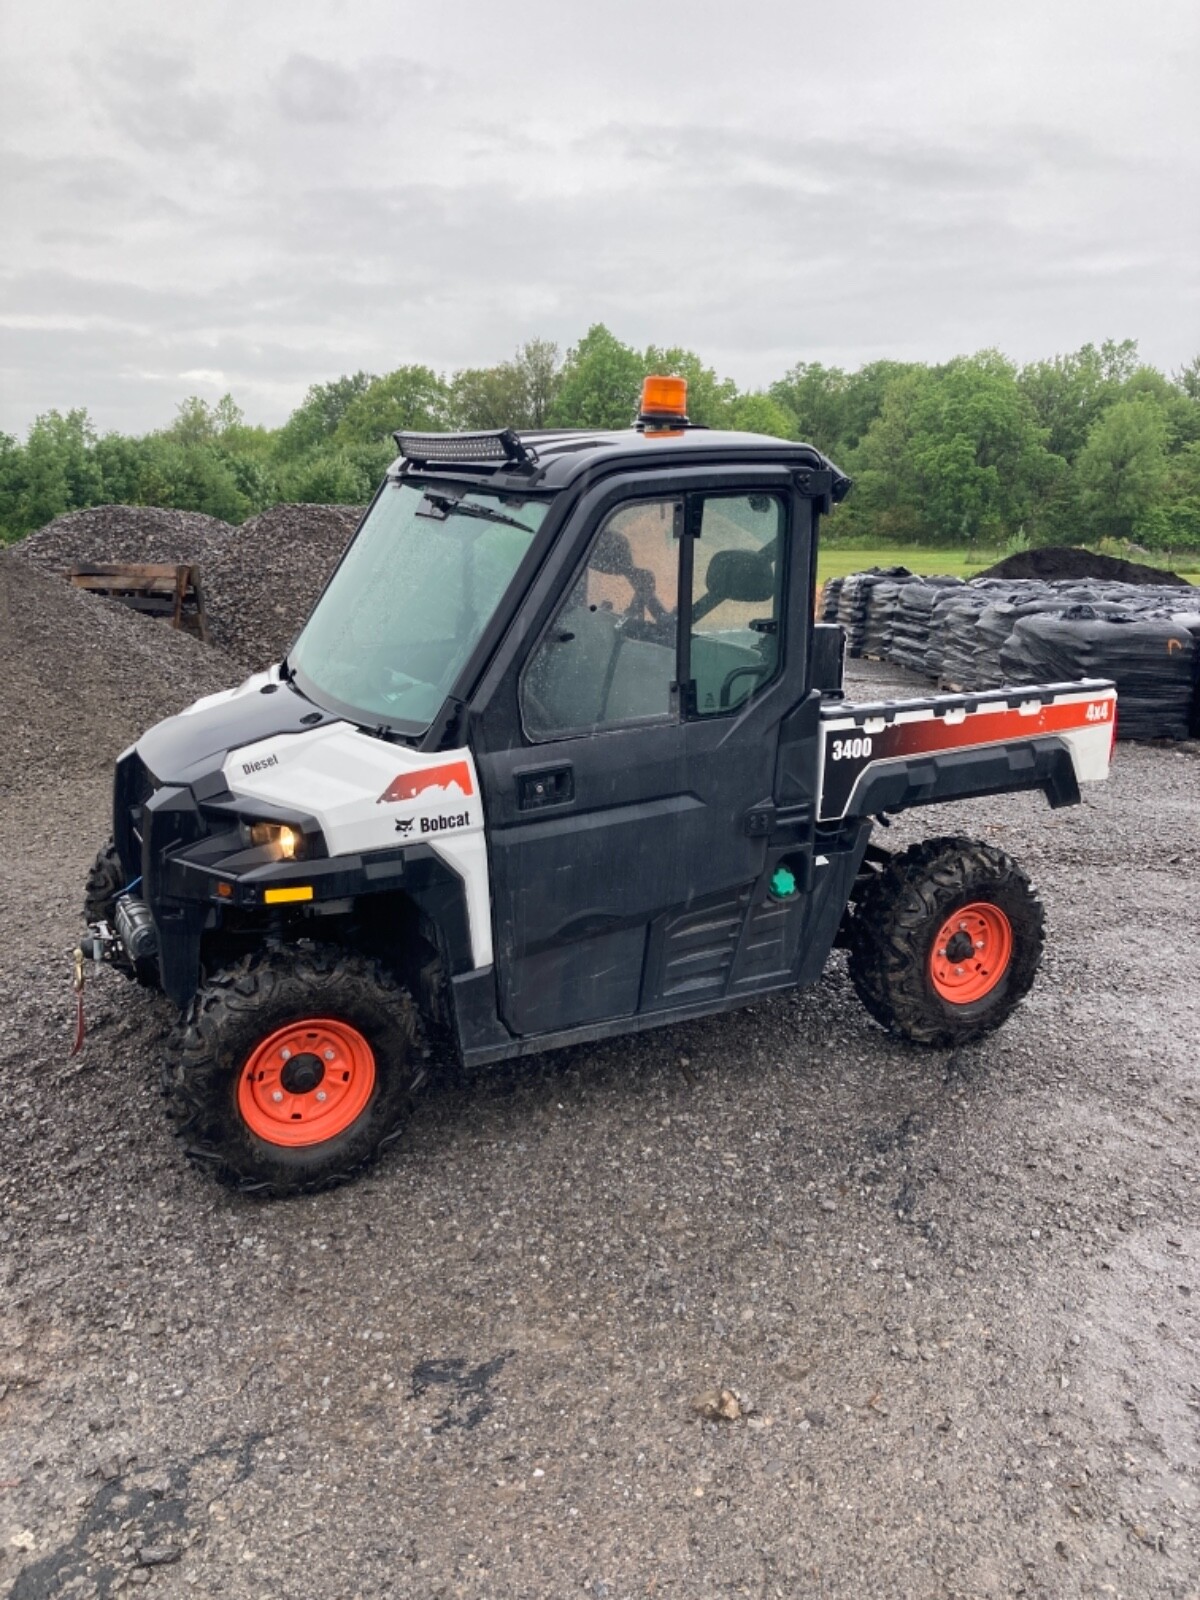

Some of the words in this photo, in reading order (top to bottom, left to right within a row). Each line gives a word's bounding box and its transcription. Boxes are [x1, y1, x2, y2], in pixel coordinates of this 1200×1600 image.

[1085, 701, 1109, 721] 4x4
[832, 737, 872, 761] 3400
[242, 753, 279, 775] Diesel
[420, 811, 470, 833] Bobcat
